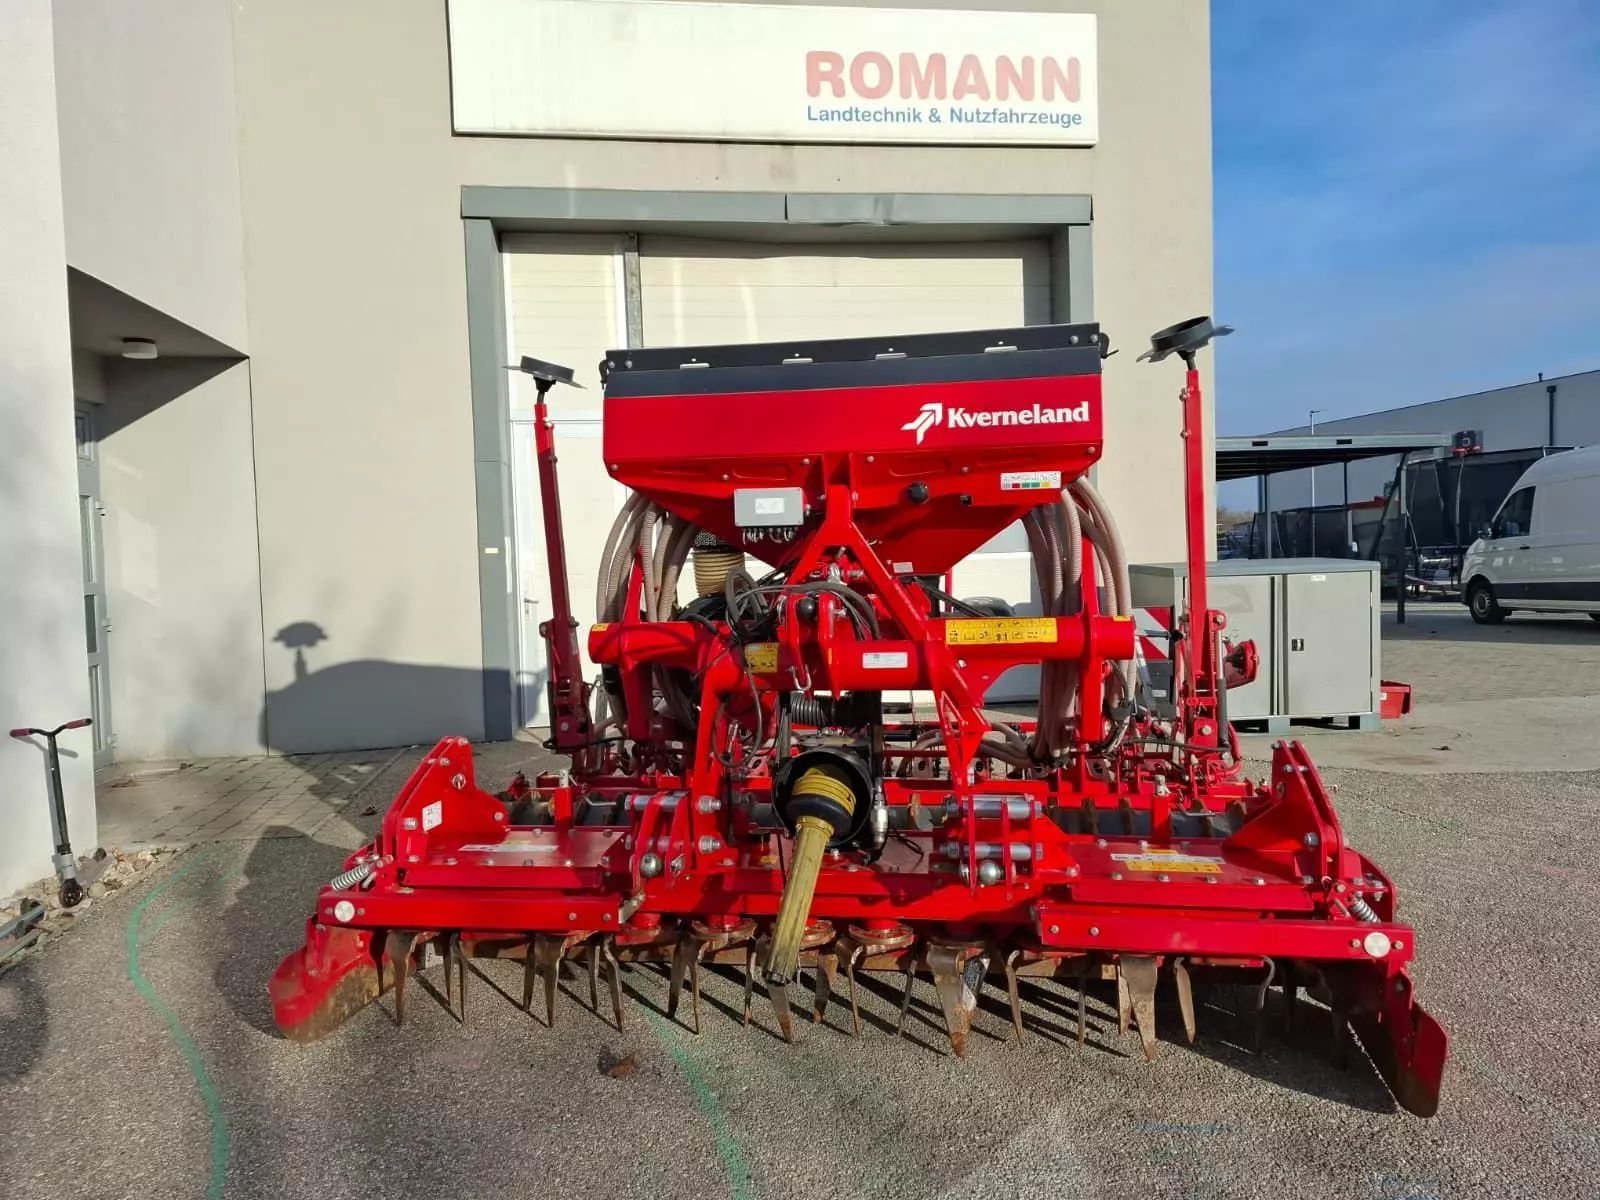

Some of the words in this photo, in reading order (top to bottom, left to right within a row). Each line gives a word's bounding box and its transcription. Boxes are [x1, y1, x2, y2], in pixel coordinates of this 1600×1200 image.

[806, 51, 1080, 102] ROMANN
[807, 106, 922, 123] Landtechnik
[928, 108, 942, 123] &
[950, 108, 1082, 128] Nutzfahrzeuge
[948, 401, 1090, 428] Kverneland
